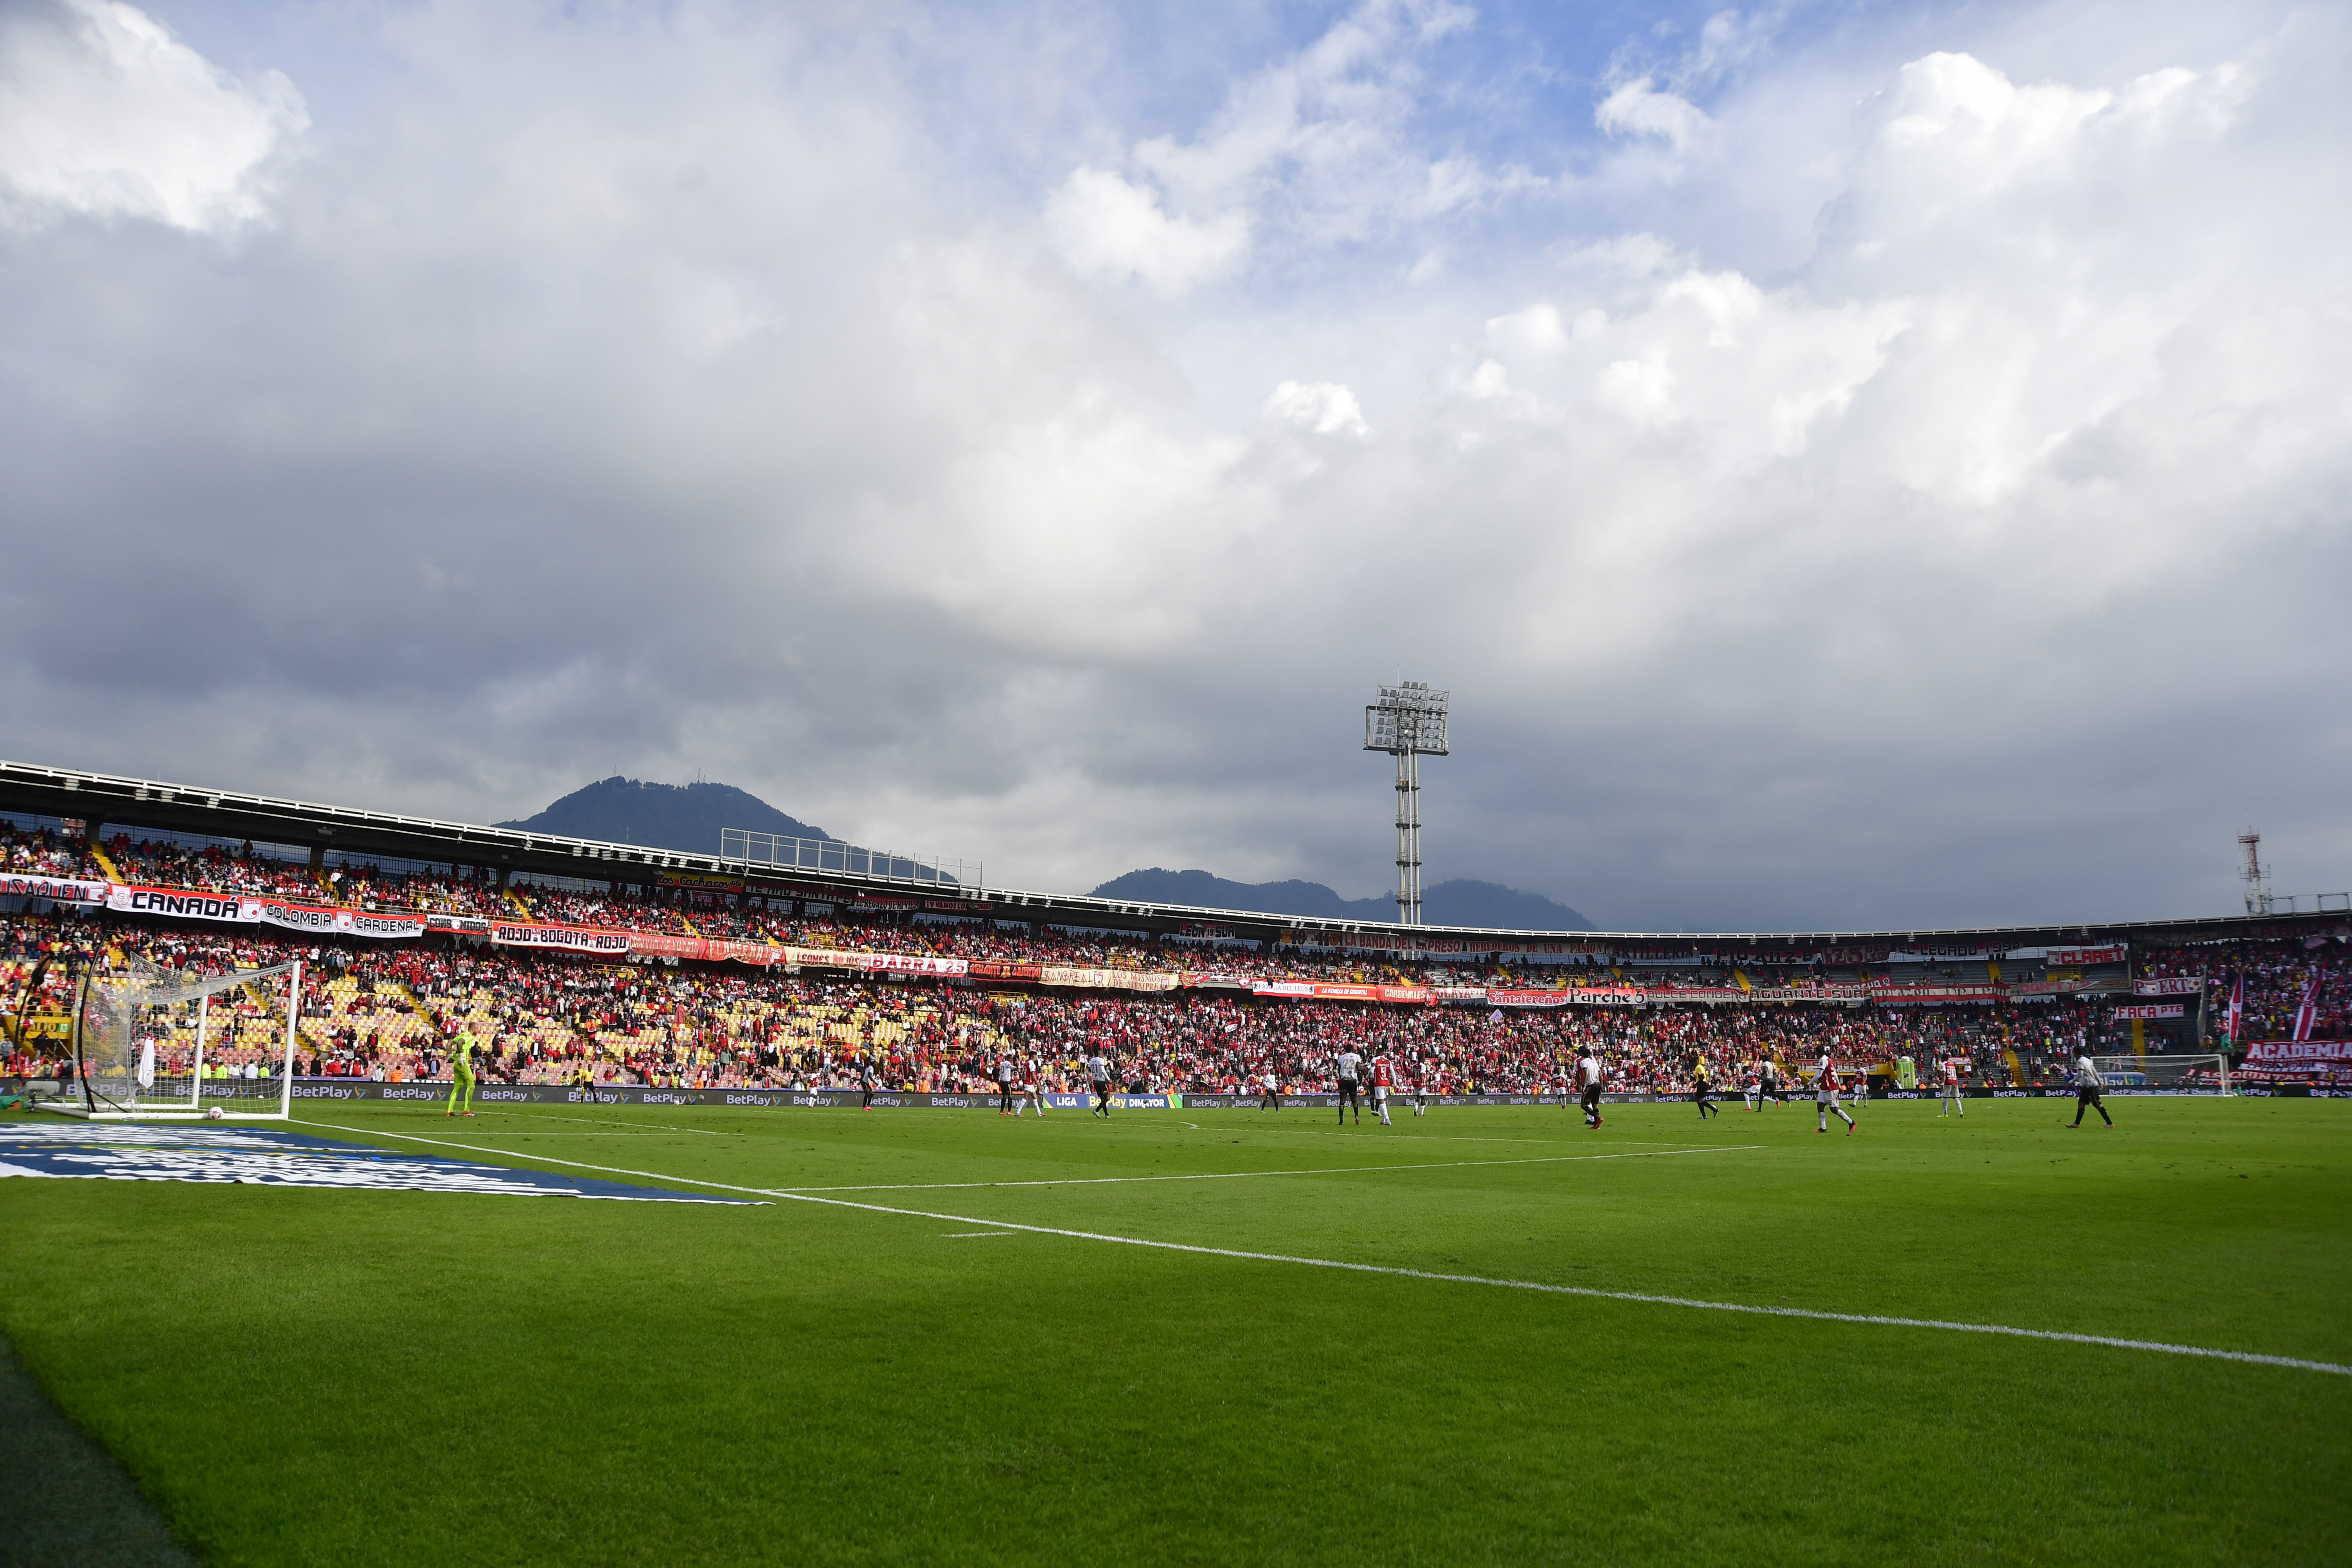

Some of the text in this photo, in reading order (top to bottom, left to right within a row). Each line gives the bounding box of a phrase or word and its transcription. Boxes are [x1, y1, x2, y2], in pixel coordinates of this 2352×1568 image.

[680, 876, 728, 888] Cachacos
[132, 892, 239, 918] CANADÁ
[857, 897, 863, 907] EL
[865, 898, 888, 909] REGALO
[889, 900, 896, 909] DE
[267, 904, 332, 926] COLOMBIA
[356, 917, 420, 932] CARDENAL
[1215, 924, 1235, 938] SUR
[498, 926, 627, 949] ROJO BOGOTA ROJO
[1345, 933, 1357, 946] LA
[1360, 934, 1392, 949] BANDA
[1395, 936, 1413, 950] DEL
[1470, 940, 1603, 953] HEREDEROS DE UNA PASION
[1612, 945, 1693, 959] ARTILLERIA
[1899, 945, 1914, 954] EL
[1921, 945, 1978, 956] LEGADO
[797, 952, 830, 964] LEONES
[2061, 947, 2123, 964] CLARET
[873, 955, 965, 973] BARRA 25
[969, 964, 1001, 977] AGUANTE
[1113, 971, 1127, 980] LOS
[1130, 972, 1160, 982] MISMOS
[1127, 980, 1158, 991] SIEMPRE
[1385, 988, 1426, 999] CARDENALES
[1436, 989, 1471, 998] OLAYA
[1489, 993, 1565, 1004] Santafereños
[1569, 988, 1645, 1003] Parche 5
[1647, 990, 1687, 999] DULCE
[1752, 989, 1864, 999] AGUANTE SUR
[2118, 1005, 2183, 1018] FACA PTE
[2248, 1042, 2352, 1059] ACADEMIA
[1343, 1059, 1355, 1070] 23
[292, 1086, 352, 1100] BetPlay
[383, 1088, 435, 1101] BetPlay
[482, 1090, 528, 1102] BetPlay
[1887, 1092, 1919, 1100] BetPlay
[1993, 1090, 2028, 1098] BetPlay
[727, 1094, 771, 1106] BetPlay
[931, 1097, 969, 1108] BetPlay
[1056, 1097, 1077, 1106] LIGA
[1192, 1099, 1221, 1108] BetPlay
[1235, 1099, 1261, 1108] BetPlay
